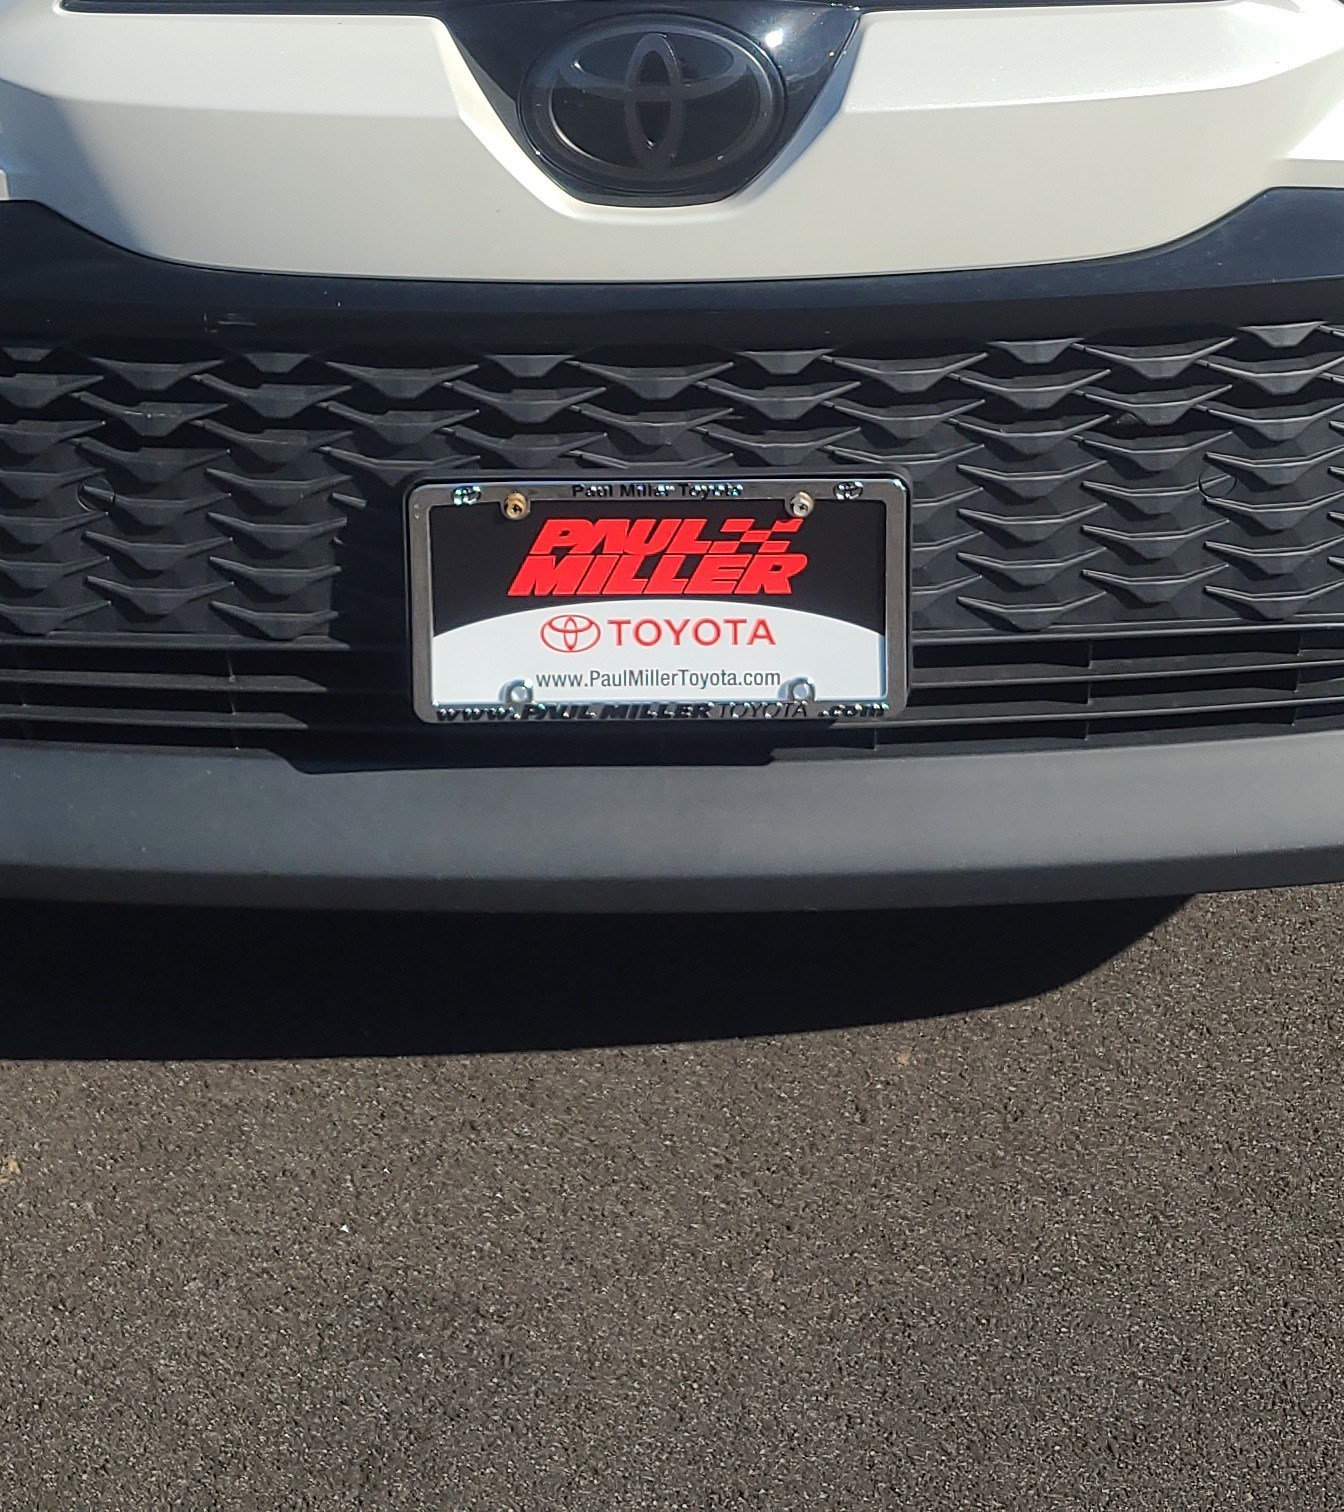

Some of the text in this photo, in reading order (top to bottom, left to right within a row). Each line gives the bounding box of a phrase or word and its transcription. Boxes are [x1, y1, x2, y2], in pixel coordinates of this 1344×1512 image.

[571, 483, 613, 497] Paul
[619, 483, 675, 497] Miller
[529, 518, 710, 555] PAUL
[507, 553, 808, 596] MILLER
[607, 618, 777, 647] TOYOTA
[535, 668, 782, 690] www.PaulMillerToyota.com
[599, 702, 711, 719] MILLER
[718, 701, 808, 719] TOYOTA
